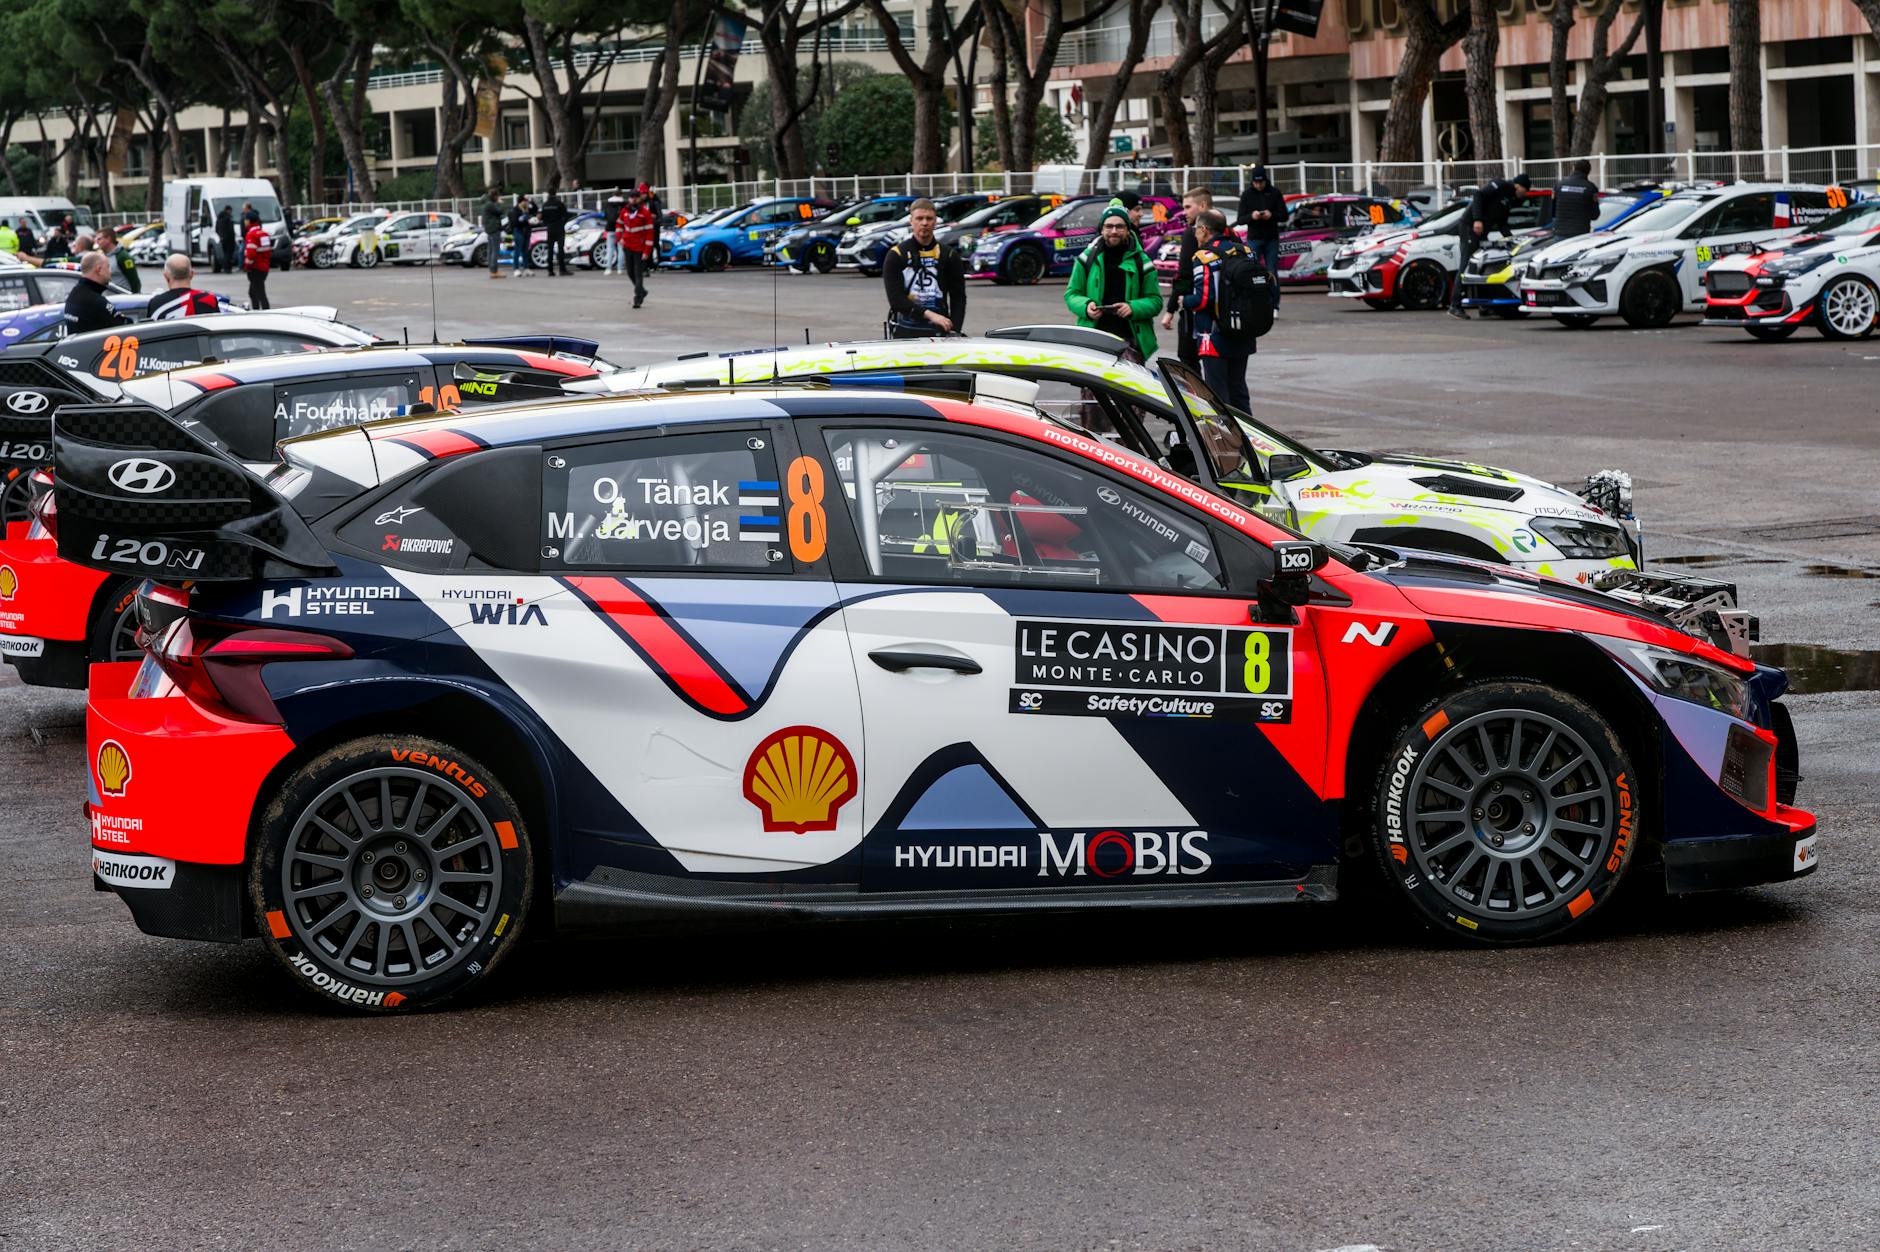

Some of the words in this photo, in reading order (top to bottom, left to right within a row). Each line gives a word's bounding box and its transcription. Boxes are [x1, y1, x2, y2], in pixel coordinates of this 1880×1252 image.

[1696, 246, 1712, 262] 56
[99, 335, 139, 380] 26
[1044, 428, 1246, 526] motorsport.hyundai.com
[637, 478, 730, 505] Tänak
[787, 455, 827, 563] 8
[548, 512, 584, 538] M.
[1122, 502, 1180, 543] HYUNDAI
[307, 586, 400, 600] HYUNDAI
[442, 589, 512, 600] HYUNDAI
[306, 601, 375, 615] STEEL
[469, 598, 549, 626] WIA
[1021, 628, 1057, 658] LE
[1066, 631, 1216, 663] CASINO
[1244, 632, 1271, 694] 8
[1087, 695, 1215, 716] SafetyCulture
[101, 814, 143, 831] HYUNDAI
[101, 829, 130, 844] STEEL
[895, 846, 1026, 867] HYUNDAI
[1037, 830, 1212, 877] MOBIS
[100, 861, 167, 881] Hankook
